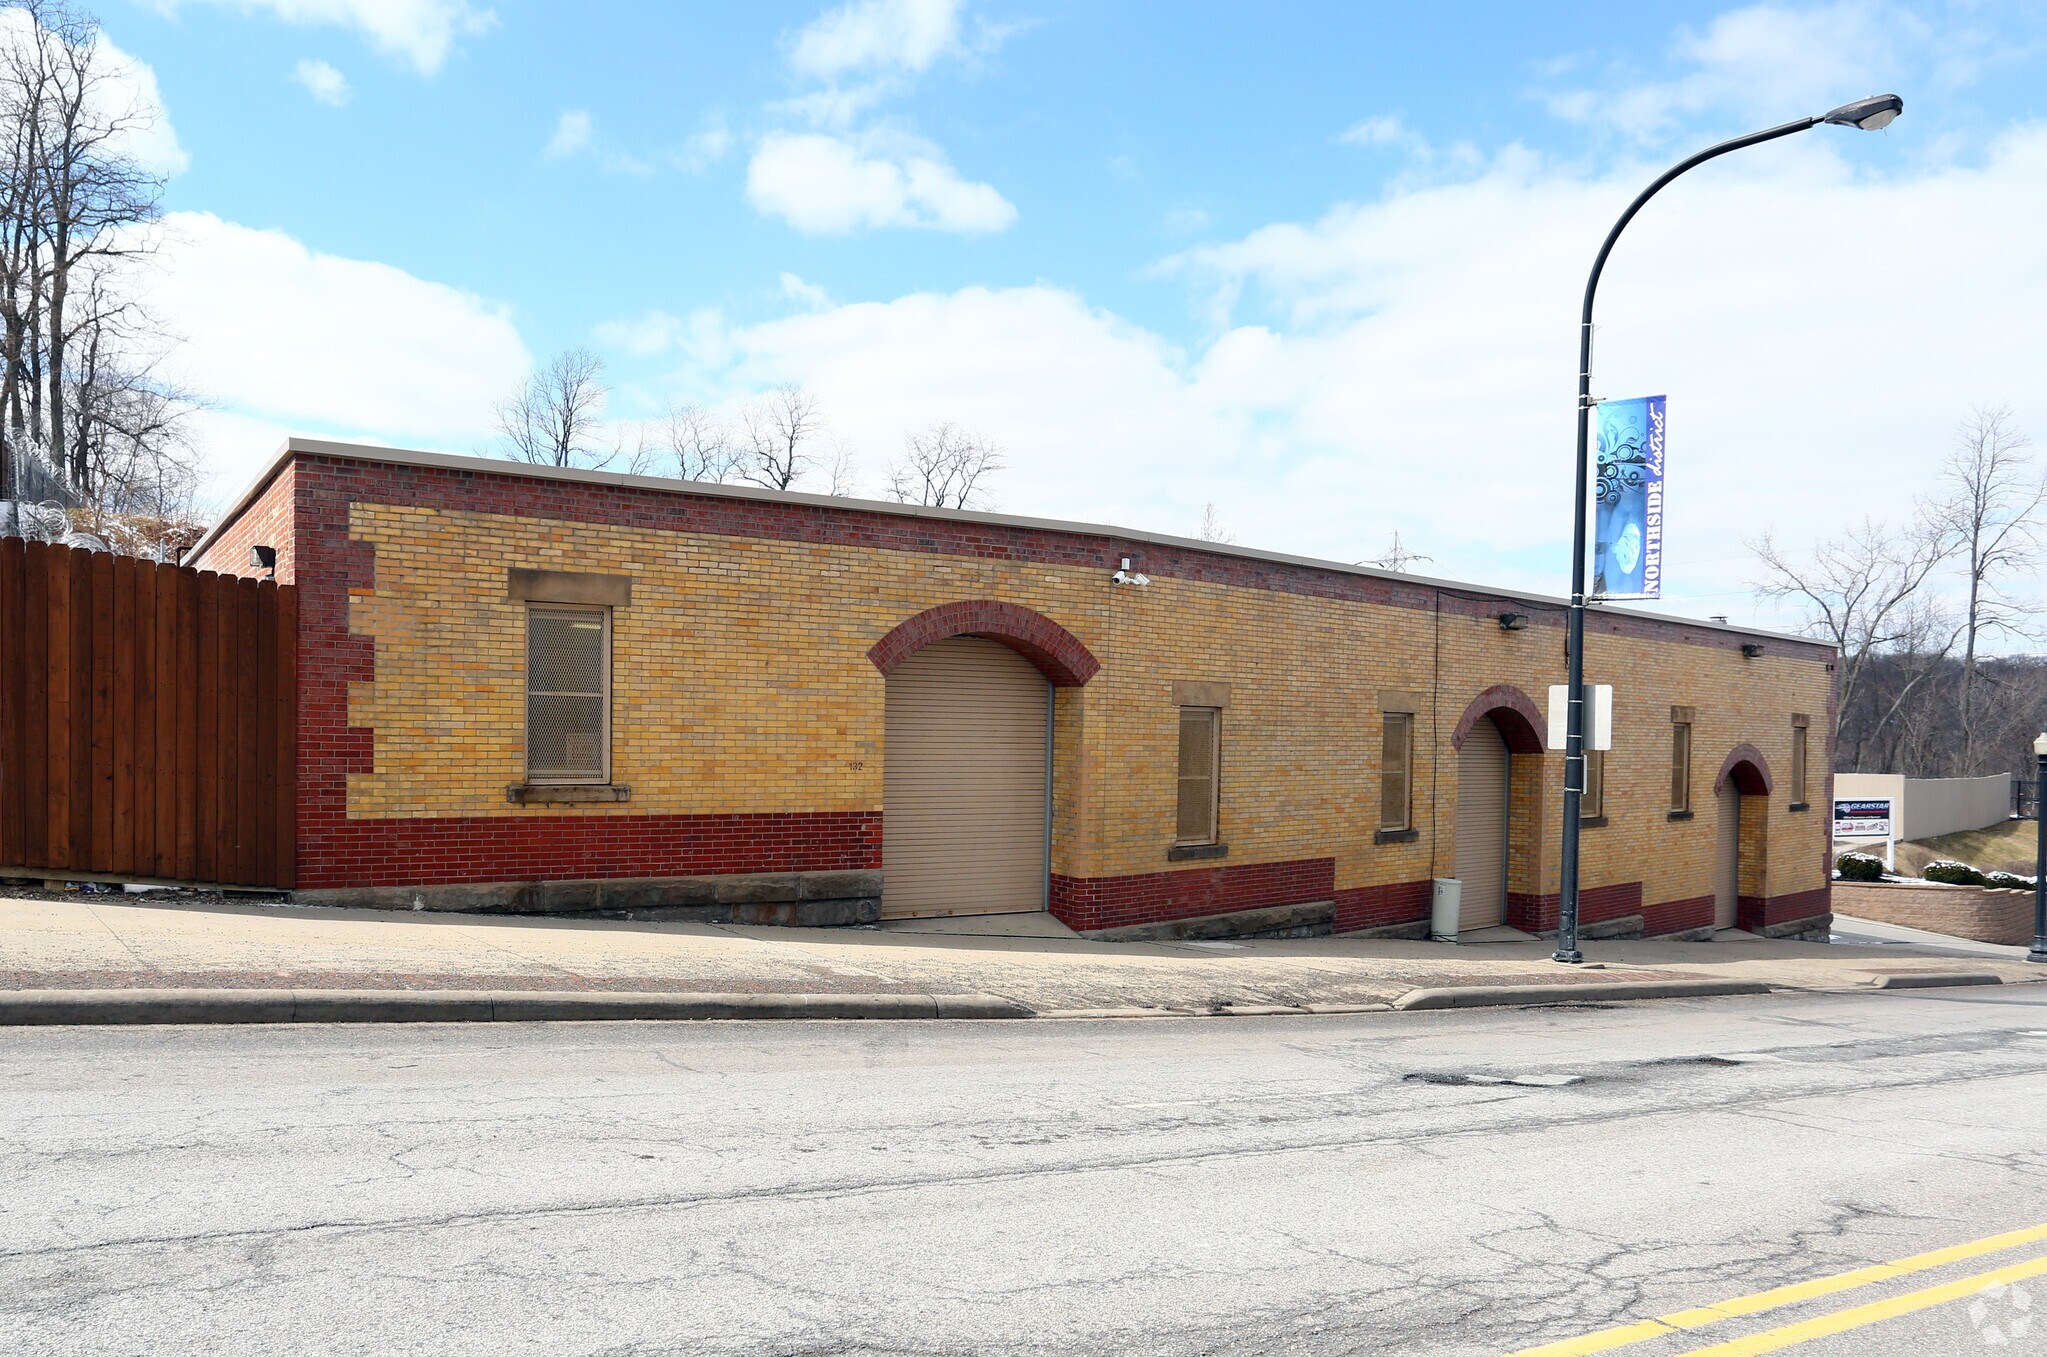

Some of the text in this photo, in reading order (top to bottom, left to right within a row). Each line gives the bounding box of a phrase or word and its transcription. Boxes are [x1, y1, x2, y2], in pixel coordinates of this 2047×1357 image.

[1644, 402, 1664, 593] NORTHSIDE district
[1850, 802, 1890, 810] GEARSTAR
